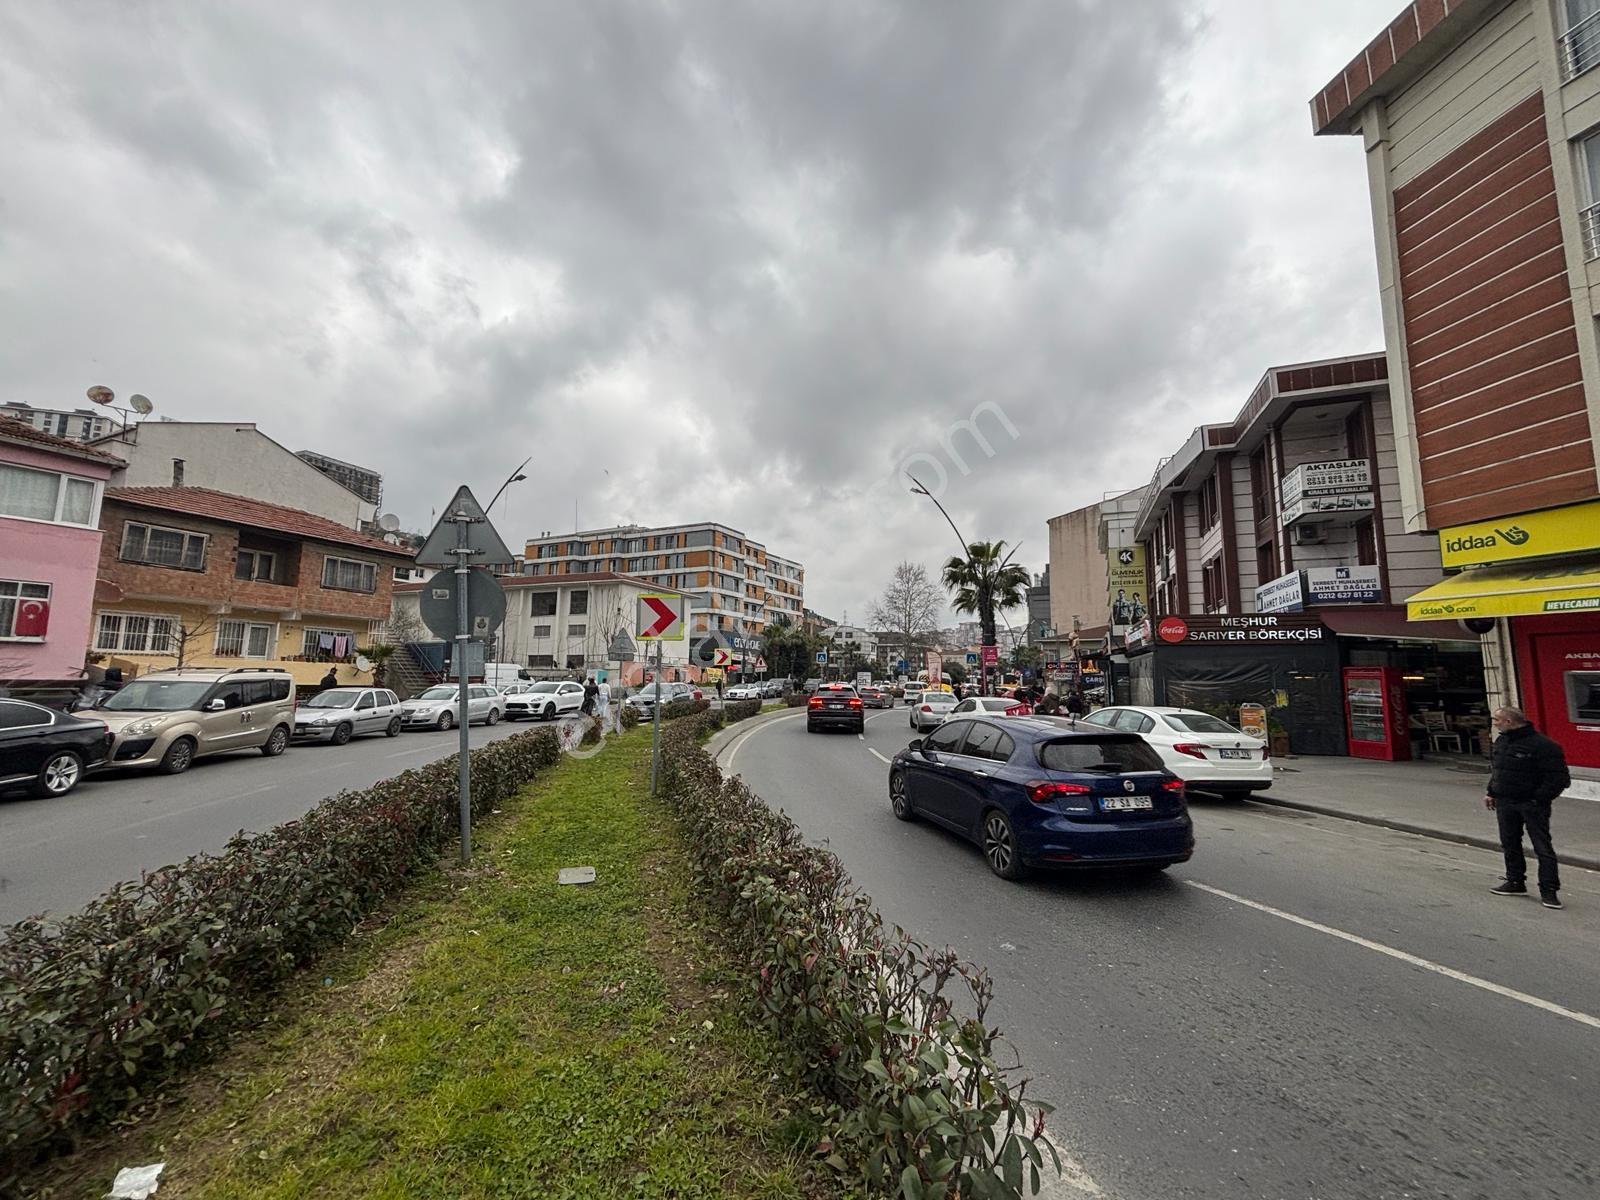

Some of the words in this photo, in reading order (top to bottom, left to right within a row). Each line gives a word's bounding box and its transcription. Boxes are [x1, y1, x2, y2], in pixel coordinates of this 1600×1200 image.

[1446, 535, 1496, 553] iddaa
[1119, 551, 1133, 562] 4K
[1546, 599, 1600, 610] HEYECANIN
[1420, 606, 1443, 615] iddaa
[1221, 616, 1278, 628] MEŞHUR
[1189, 630, 1246, 641] SARIYER
[1249, 628, 1322, 642] BÖREKÇİSİ
[1104, 799, 1116, 809] 22
